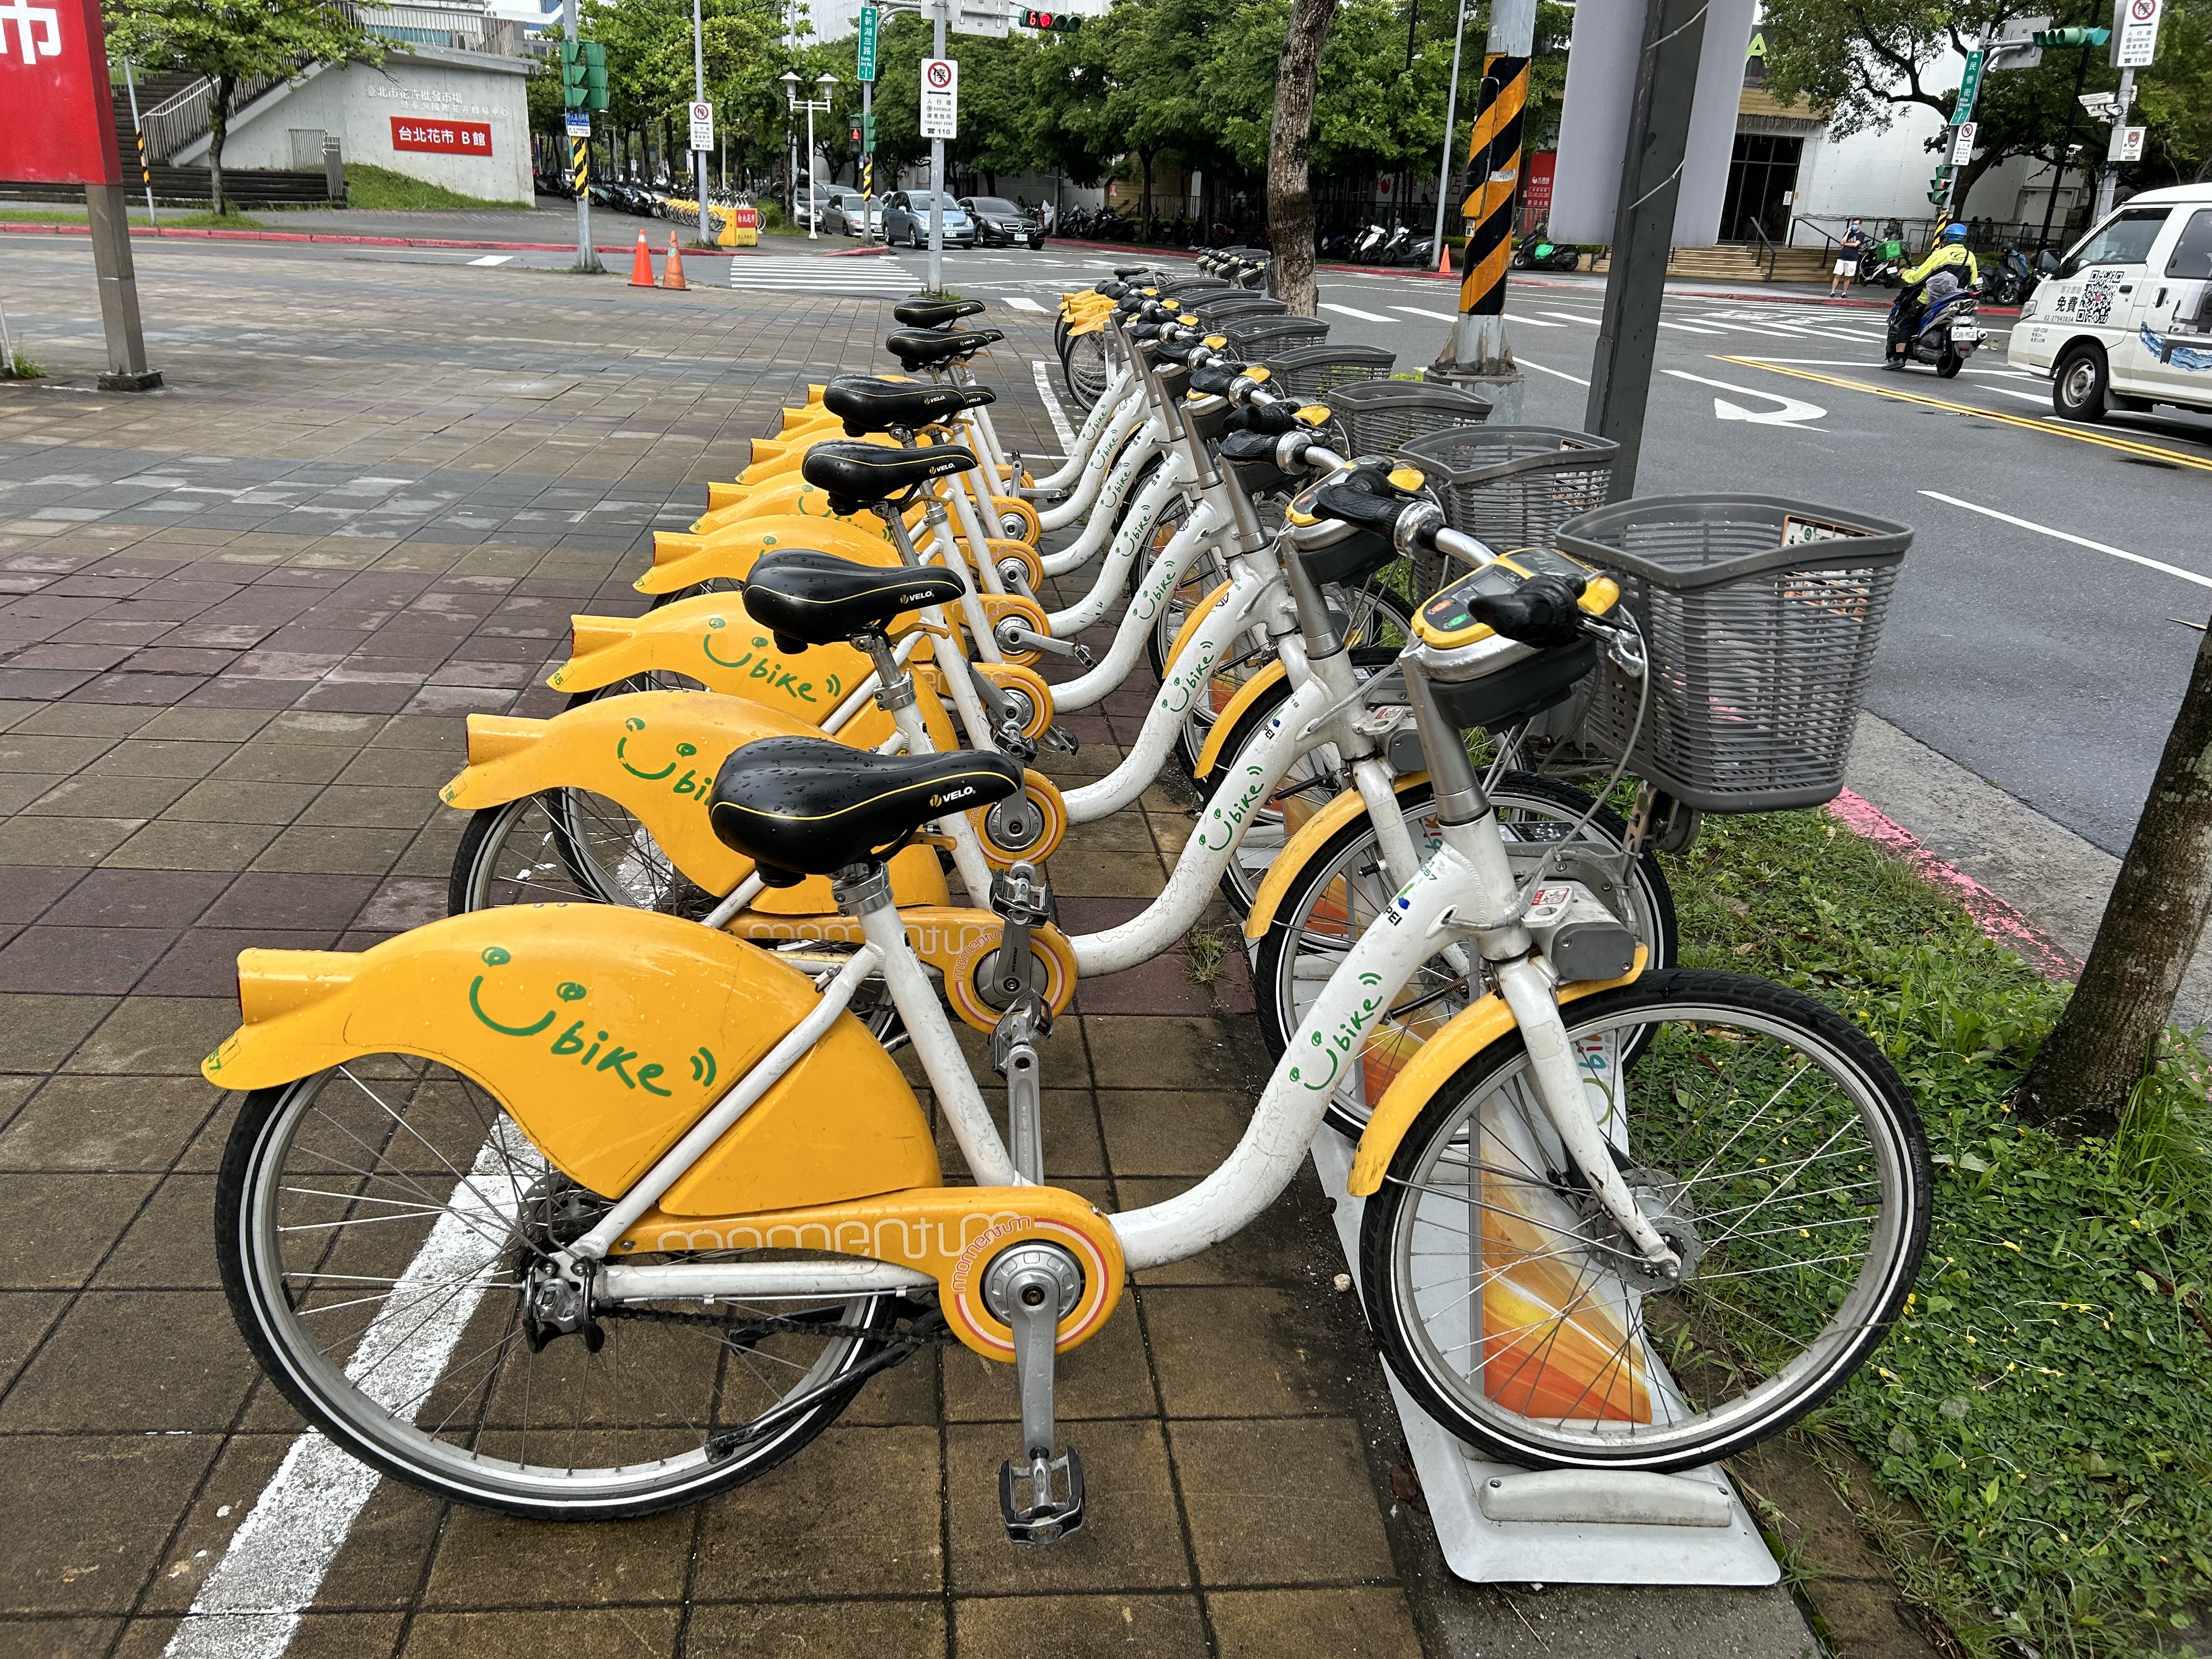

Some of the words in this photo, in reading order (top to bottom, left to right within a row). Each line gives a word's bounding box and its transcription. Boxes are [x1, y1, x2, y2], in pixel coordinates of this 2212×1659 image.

[1030, 12, 1036, 25] 6
[0, 0, 61, 65] 市
[863, 16, 873, 55] 新湖三路
[933, 69, 946, 82] 停
[1963, 62, 1977, 97] 民善街
[366, 84, 462, 104] 臺北市花卉批發市場
[398, 126, 454, 144] 台北花市
[2055, 295, 2078, 312] 免費
[2044, 314, 2073, 323] 02-27943834
[937, 462, 954, 472] VELO
[909, 591, 932, 601] VELO
[943, 786, 973, 803] VELO
[1909, 1137, 1922, 1172] KENDA
[658, 1212, 1022, 1260] momentum
[952, 1216, 1032, 1293] momentum
